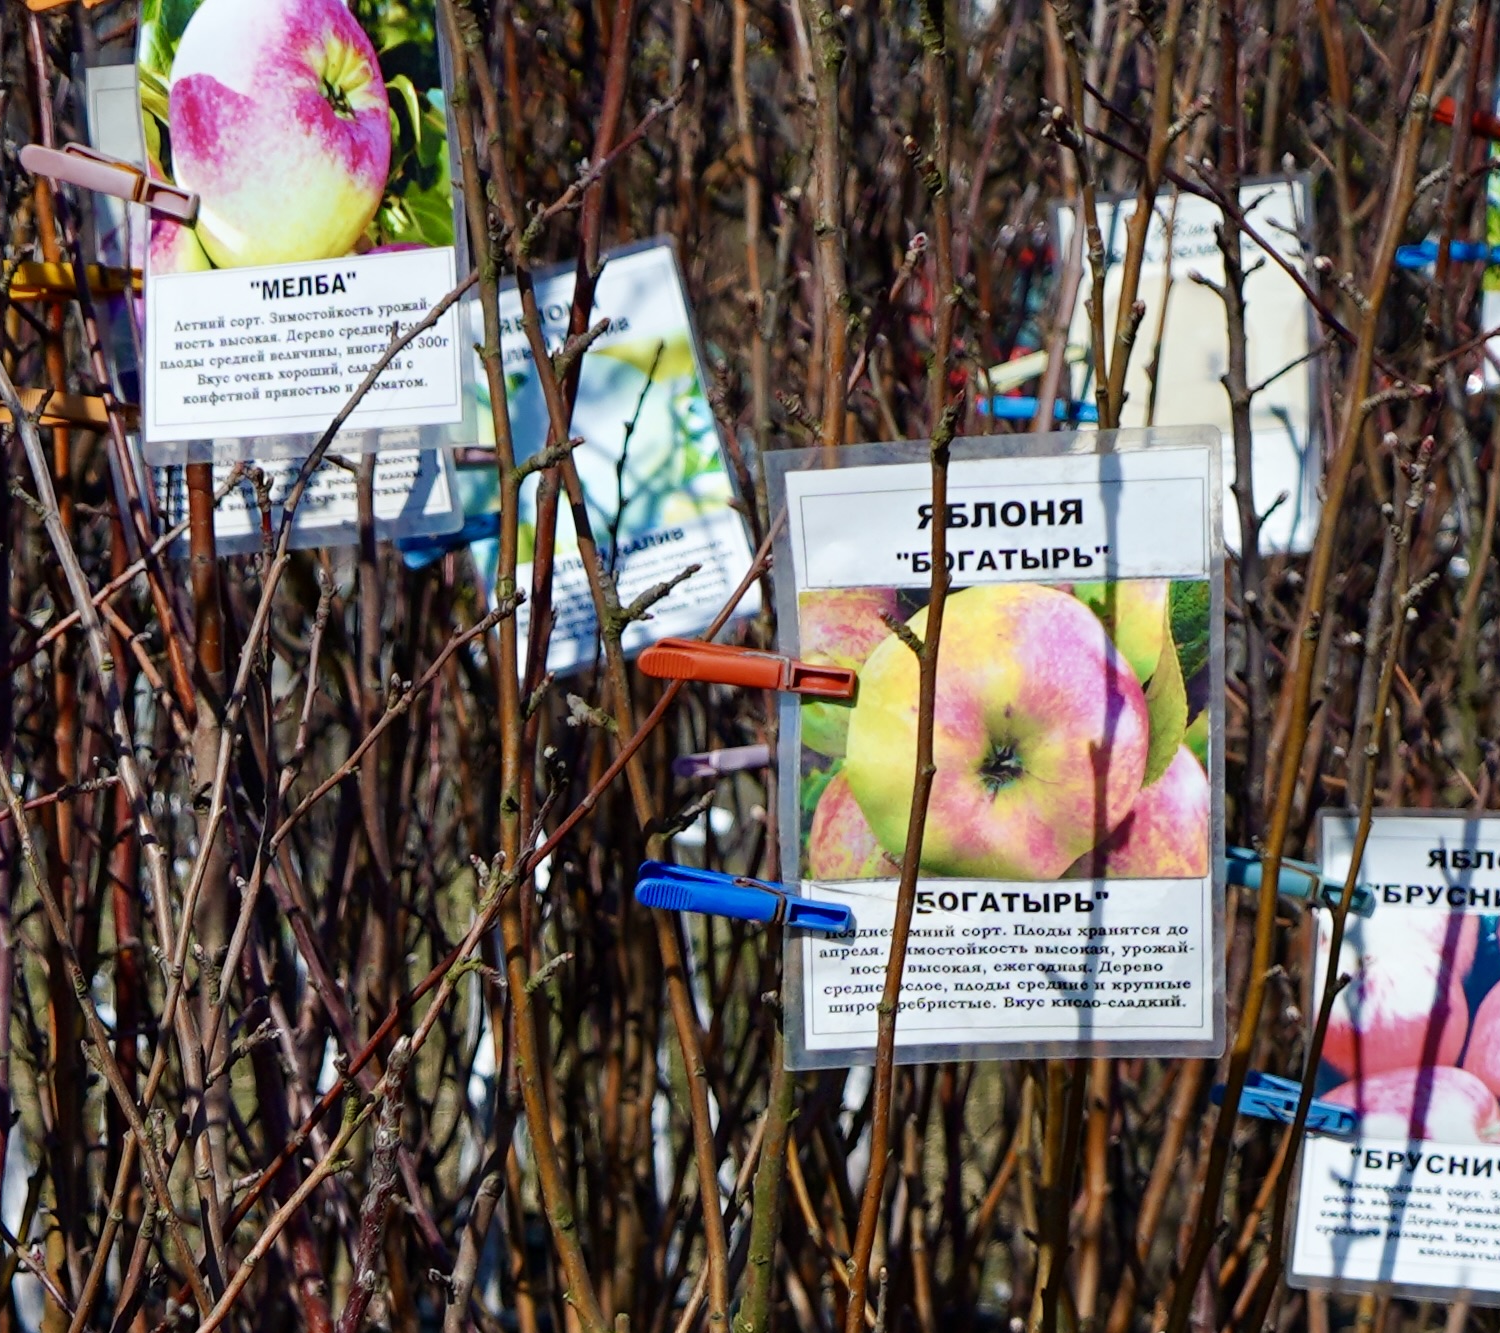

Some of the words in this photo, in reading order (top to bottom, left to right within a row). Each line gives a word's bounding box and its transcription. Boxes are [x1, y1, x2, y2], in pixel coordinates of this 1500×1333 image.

[250, 271, 356, 300] "МЕЛБА"
[173, 315, 226, 332] Летний
[229, 316, 264, 330] сорт.
[269, 305, 374, 324] Зимостойкость
[377, 297, 434, 318] урожай-
[174, 338, 214, 350] ность
[219, 333, 281, 348] высокая.
[285, 328, 334, 344] Дерево
[159, 357, 204, 370] плоды
[208, 349, 265, 369] средней
[269, 346, 342, 362] величины,
[415, 335, 450, 350] 300г
[196, 373, 230, 388] Вкус
[233, 371, 274, 384] очень
[277, 362, 344, 382] хороший,
[405, 359, 414, 370] с
[182, 387, 260, 406] конфетной
[264, 384, 340, 402] пряностью
[344, 383, 354, 394] и
[917, 499, 1083, 530] ЯБЛОНЯ
[912, 886, 1110, 916] БОГАТЫРЬ"
[961, 926, 1006, 940] сорт.
[1013, 923, 1072, 938] Плоды
[1077, 923, 1160, 942] хранятся
[1165, 925, 1188, 936] до
[818, 944, 884, 960] апреля.
[900, 942, 1028, 960] имостойкость
[1034, 941, 1116, 958] высокая,
[1120, 940, 1194, 958] урожай-
[907, 963, 986, 974] высокая,
[993, 957, 1096, 976] ежегодная.
[1095, 958, 1164, 976] Дерево
[953, 981, 1010, 992] плоды
[1016, 977, 1092, 994] средние
[1092, 979, 1106, 990] и
[1111, 980, 1192, 994] крупные
[1003, 996, 1046, 1012] Вкус
[1050, 994, 1186, 1012] кисло-сладкий.
